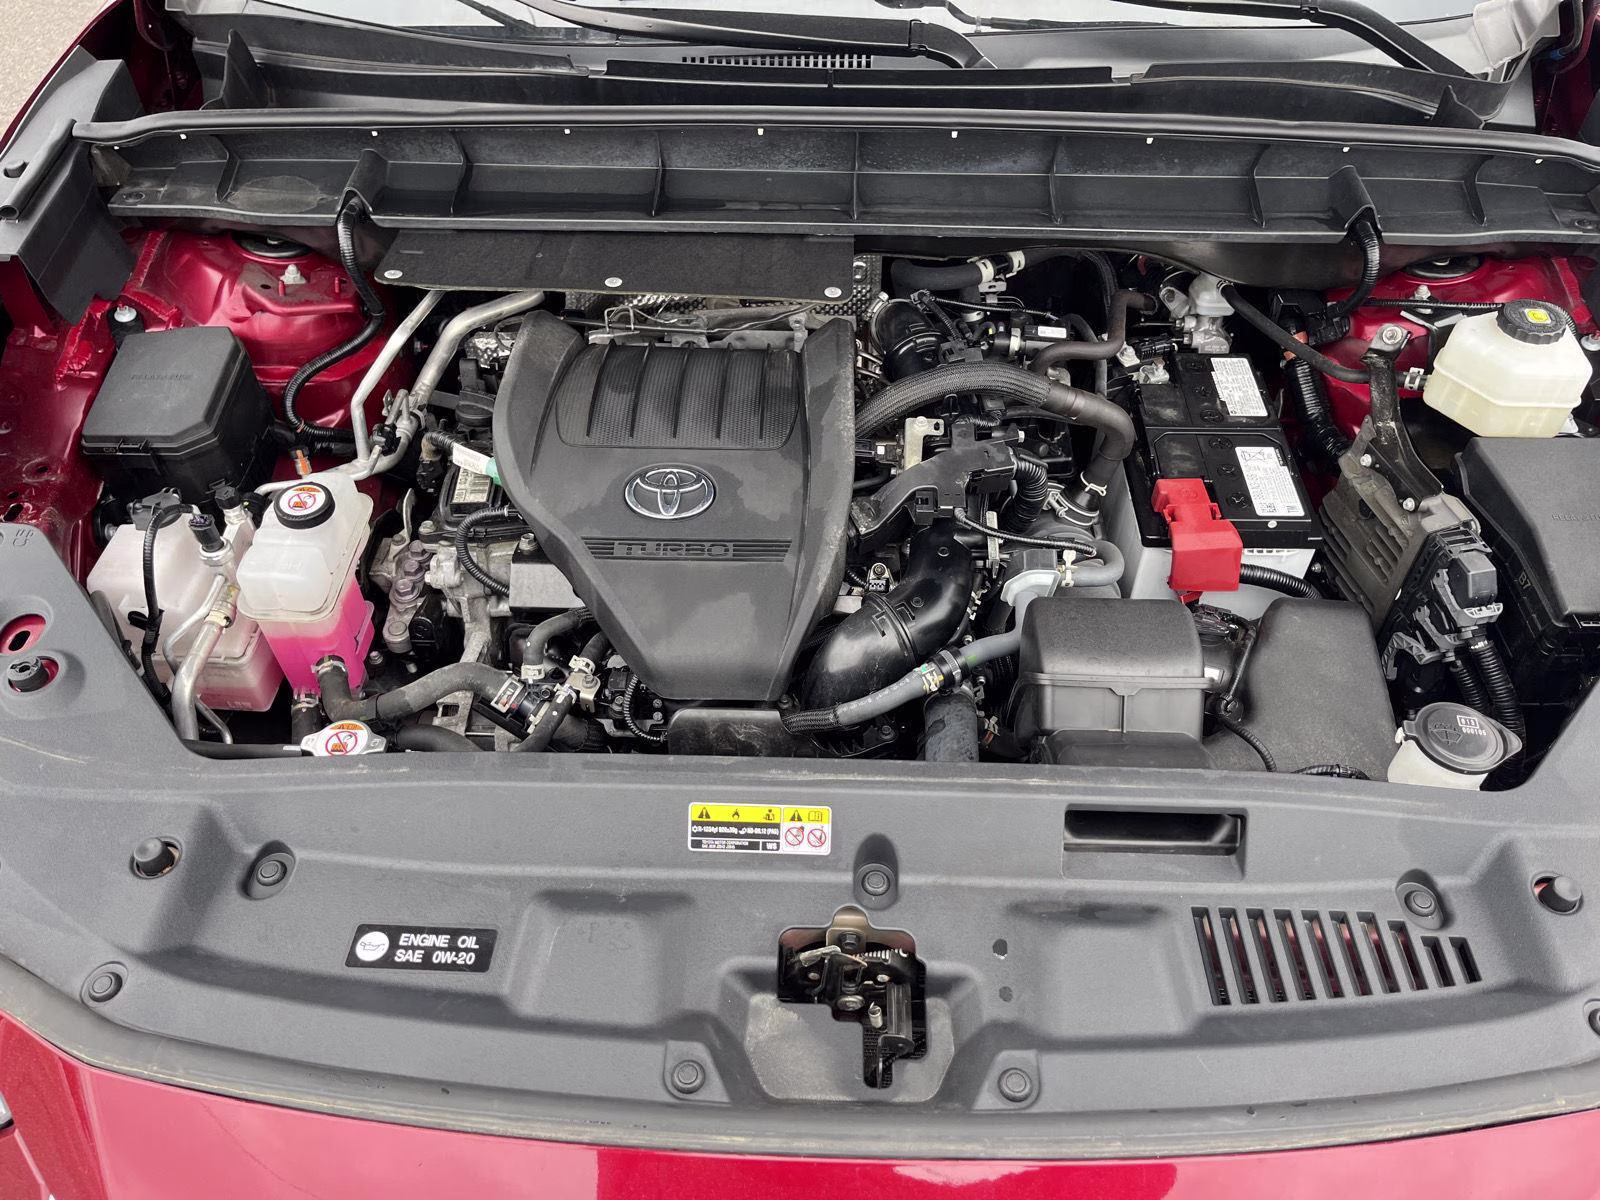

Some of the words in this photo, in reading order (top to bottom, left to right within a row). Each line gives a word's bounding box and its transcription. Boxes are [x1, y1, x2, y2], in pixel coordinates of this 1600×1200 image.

[617, 542, 730, 556] TURBO
[399, 933, 451, 947] ENGINE
[457, 935, 480, 949] OIL
[394, 949, 424, 963] SAE
[432, 950, 475, 965] 0W-20
